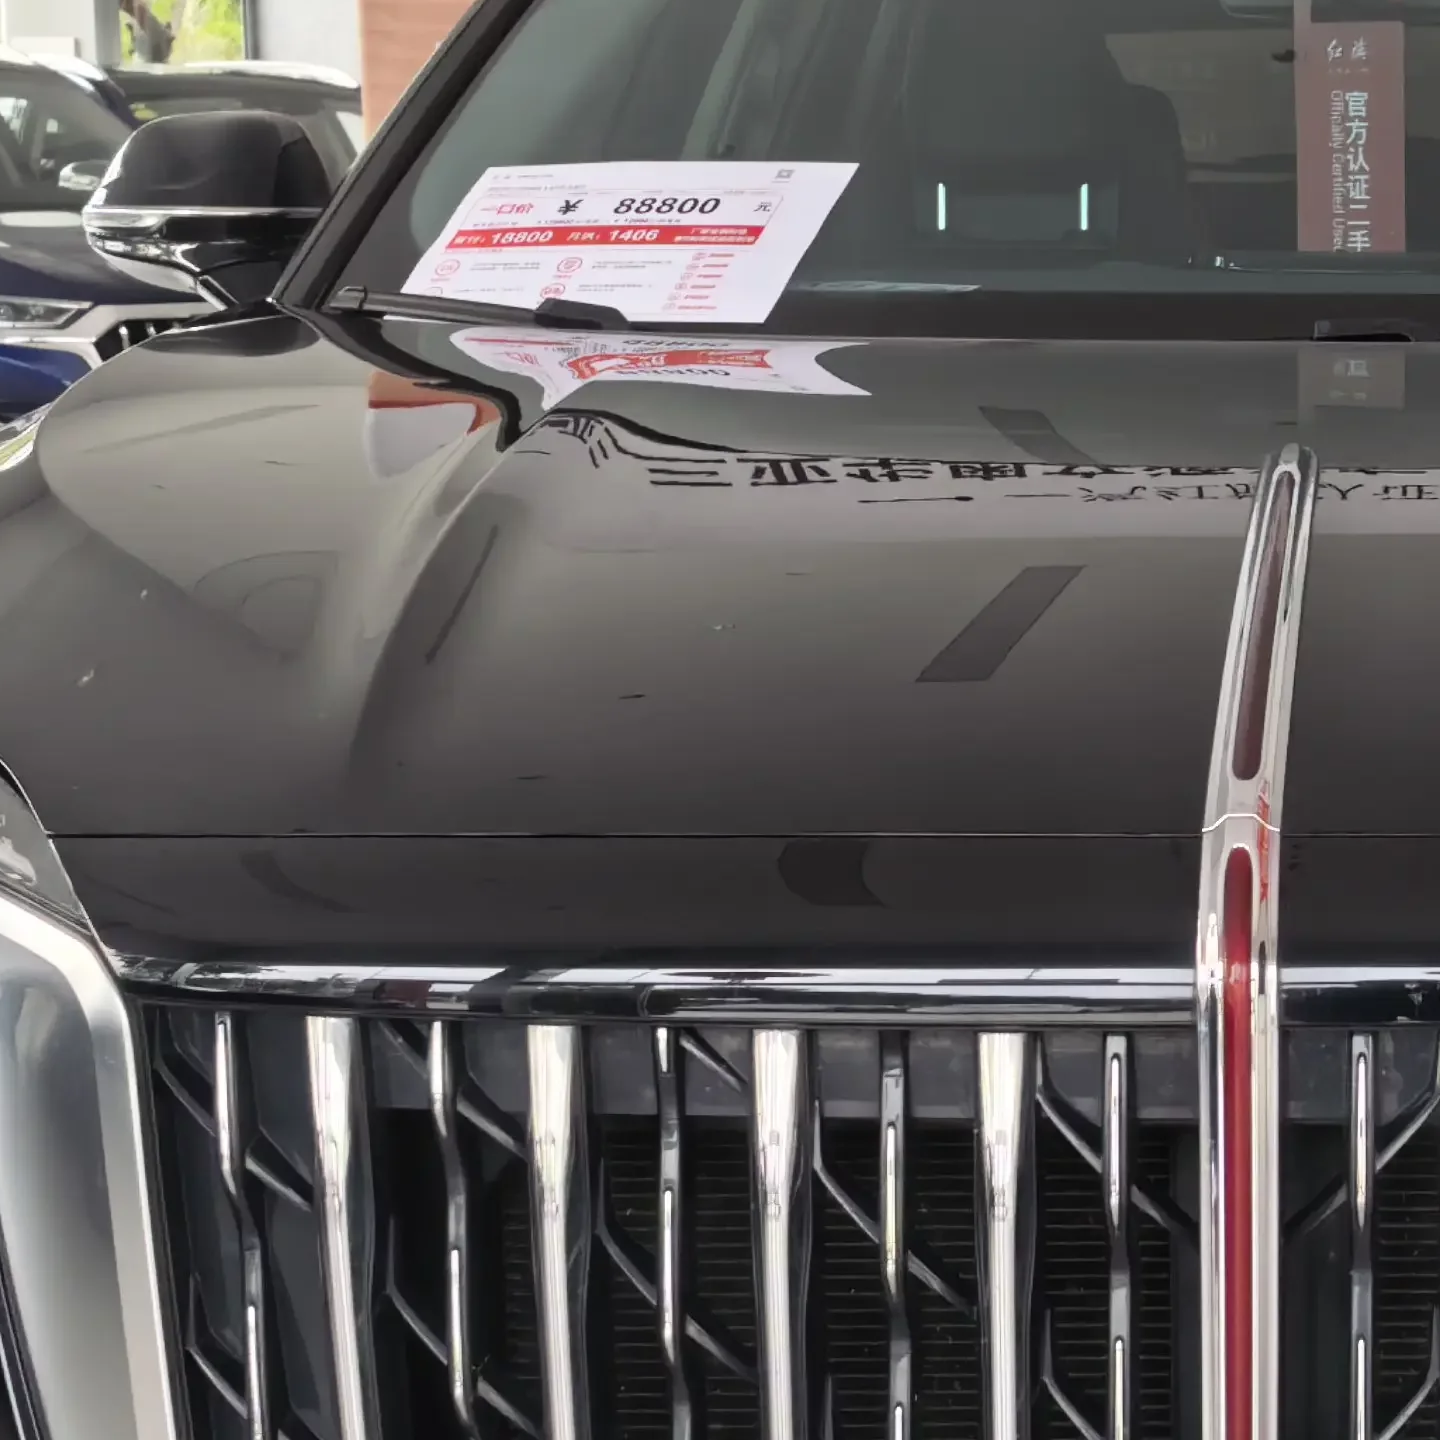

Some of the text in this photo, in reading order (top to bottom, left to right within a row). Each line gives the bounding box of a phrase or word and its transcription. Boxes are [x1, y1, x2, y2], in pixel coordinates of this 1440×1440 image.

[1345, 91, 1371, 252] 官方认证二手
[614, 197, 722, 215] 88800
[609, 229, 660, 242] 1406
